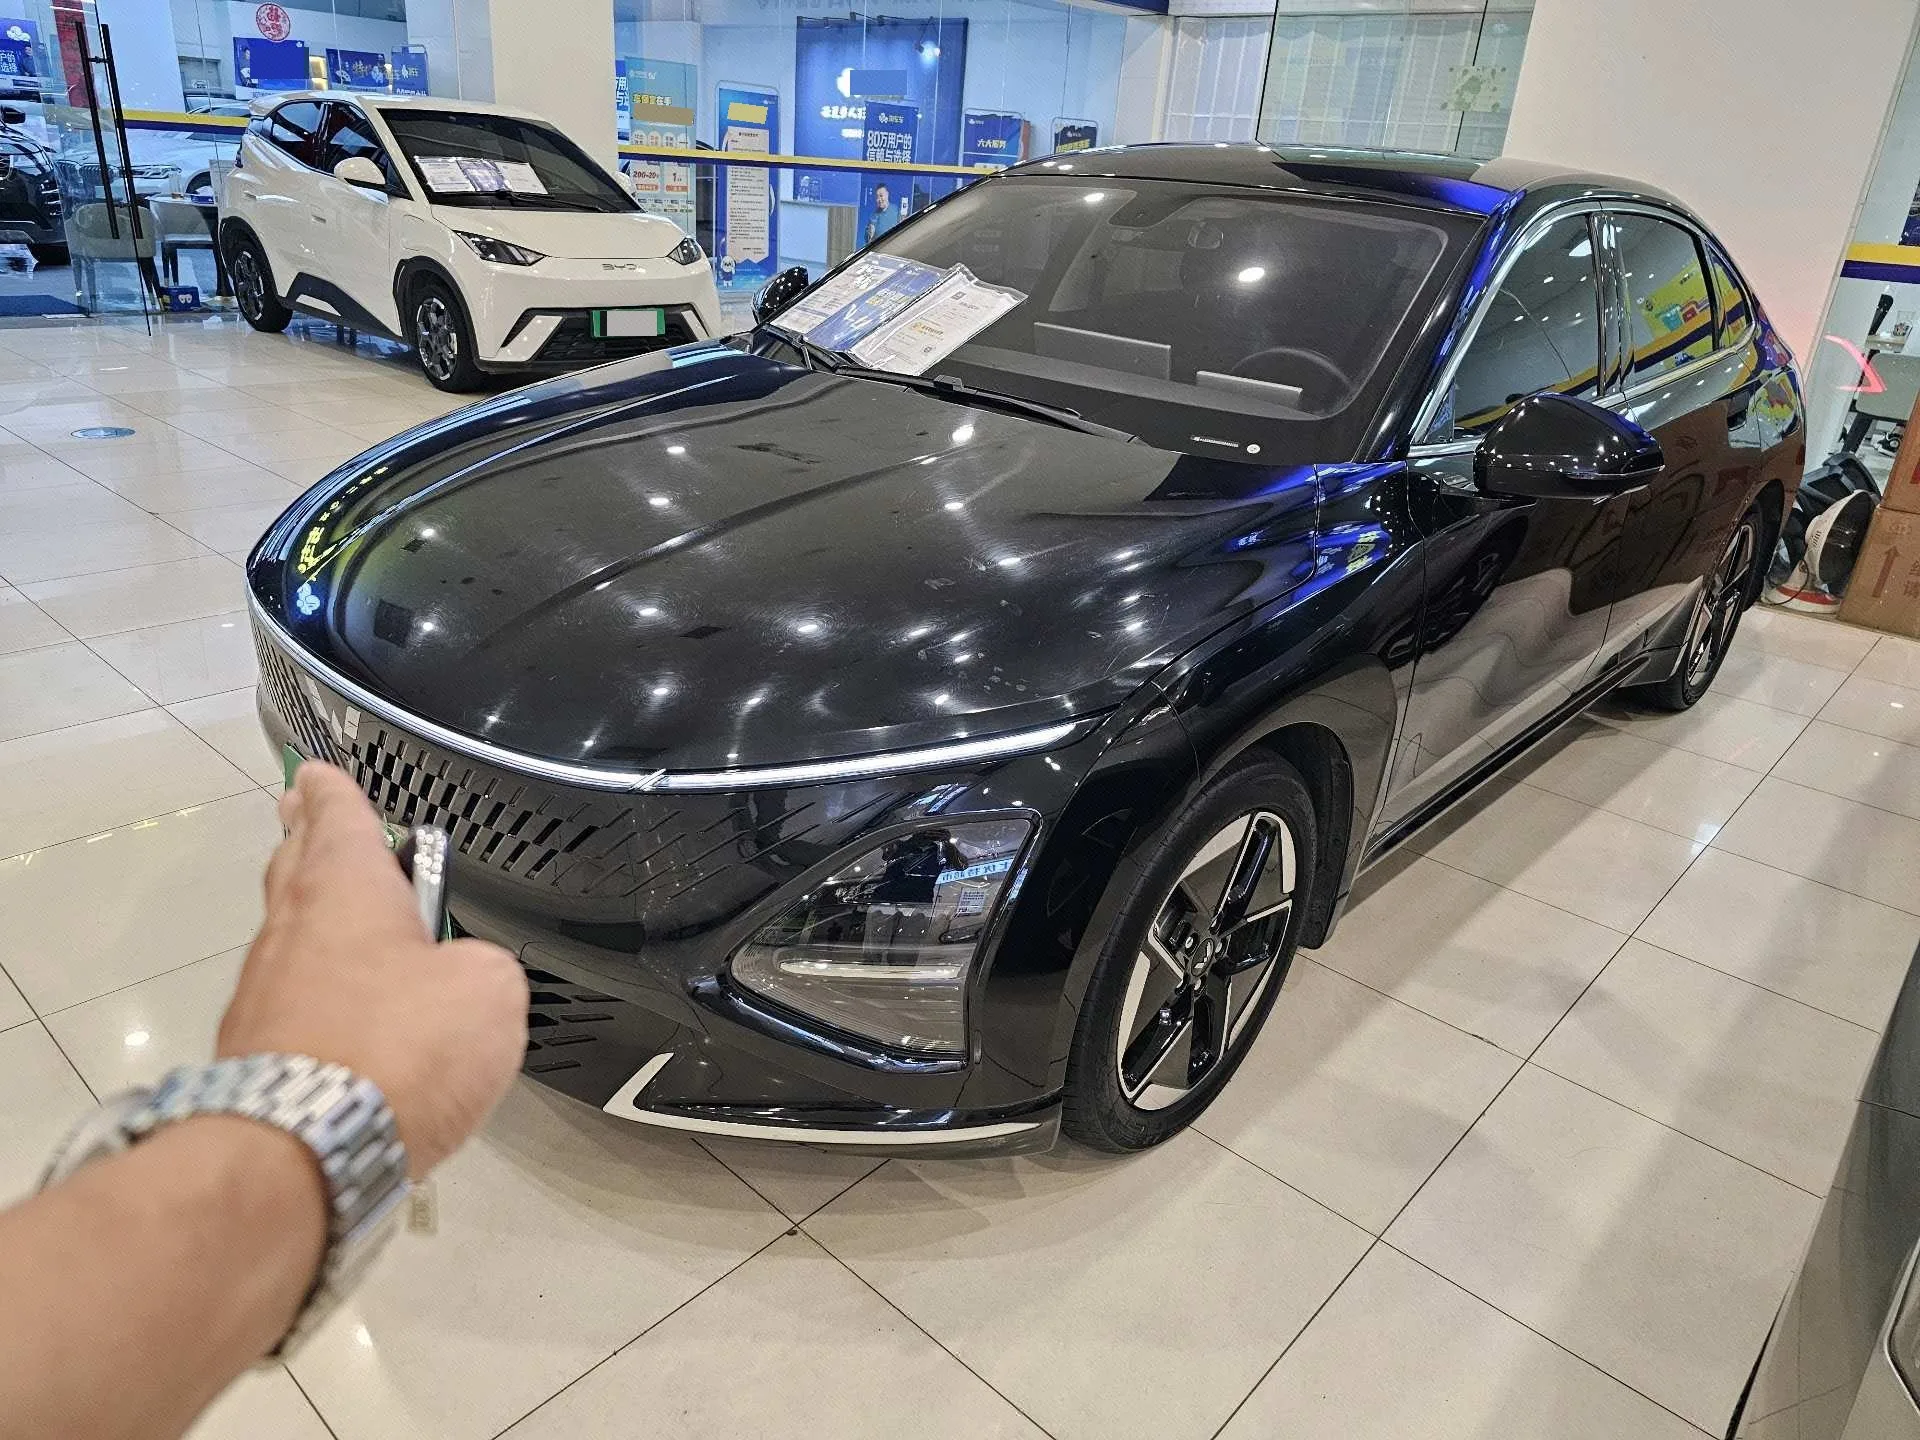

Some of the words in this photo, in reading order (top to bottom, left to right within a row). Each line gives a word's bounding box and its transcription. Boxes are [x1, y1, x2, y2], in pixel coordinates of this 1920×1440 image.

[867, 130, 912, 149] 80万用户的
[601, 263, 638, 271] BYD
